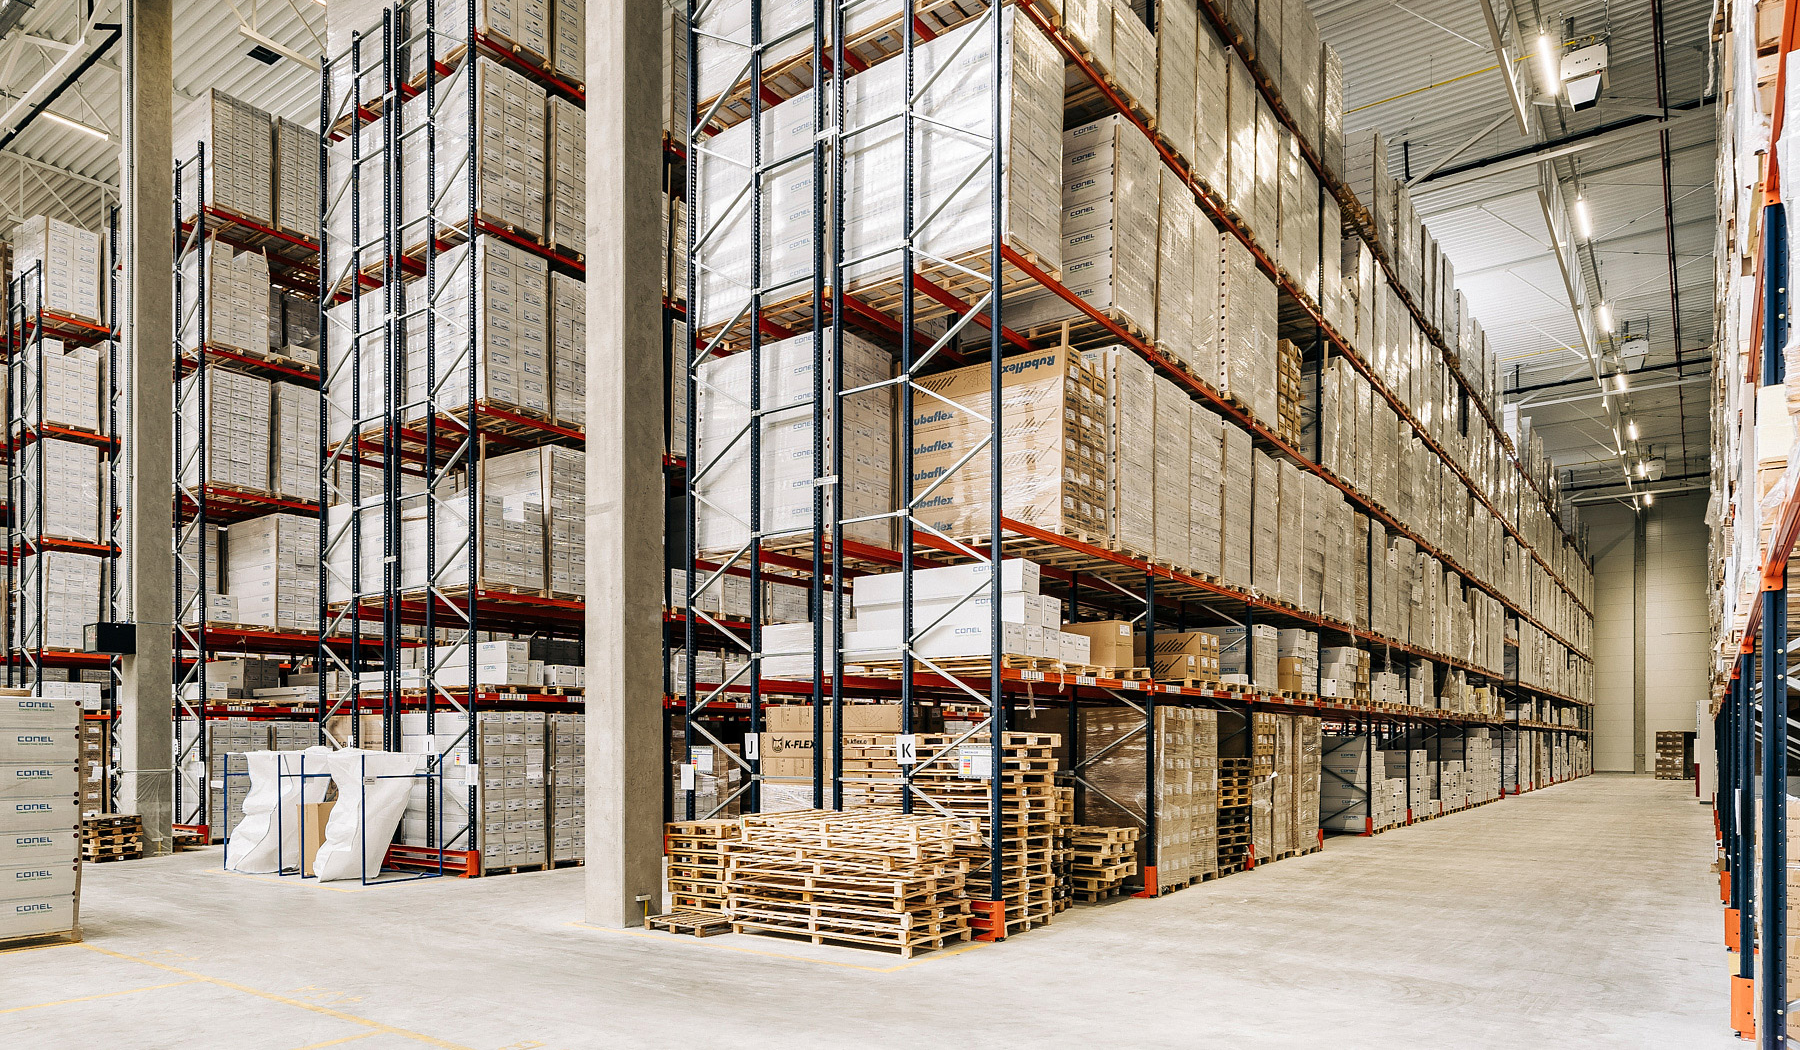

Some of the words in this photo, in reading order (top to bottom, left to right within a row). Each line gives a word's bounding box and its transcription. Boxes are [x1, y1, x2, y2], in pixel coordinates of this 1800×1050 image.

[792, 121, 814, 134] CONEL
[1073, 124, 1098, 136] CONEL
[1072, 152, 1096, 163] CONEL
[791, 180, 812, 191] CONEL
[1071, 179, 1095, 190] CONEL
[789, 209, 811, 220] CONEL
[1070, 207, 1095, 217] CONEL
[789, 238, 811, 249] CONEL
[1070, 234, 1095, 244] CONEL
[1070, 261, 1094, 271] CONEL
[790, 267, 811, 277] CONEL
[1075, 289, 1094, 297] ONEL
[795, 335, 813, 344] CONE
[794, 365, 813, 374] CONE
[1002, 356, 1055, 374] Rubaflex
[913, 411, 954, 426] ubaflex
[913, 440, 954, 455] ubaflex
[914, 496, 954, 510] ubaflex
[955, 627, 981, 635] CONEL
[749, 740, 753, 754] J
[785, 740, 814, 749] K-FLEX
[902, 743, 911, 758] K
[16, 870, 52, 878] CONEL
[16, 903, 52, 912] CONEL
